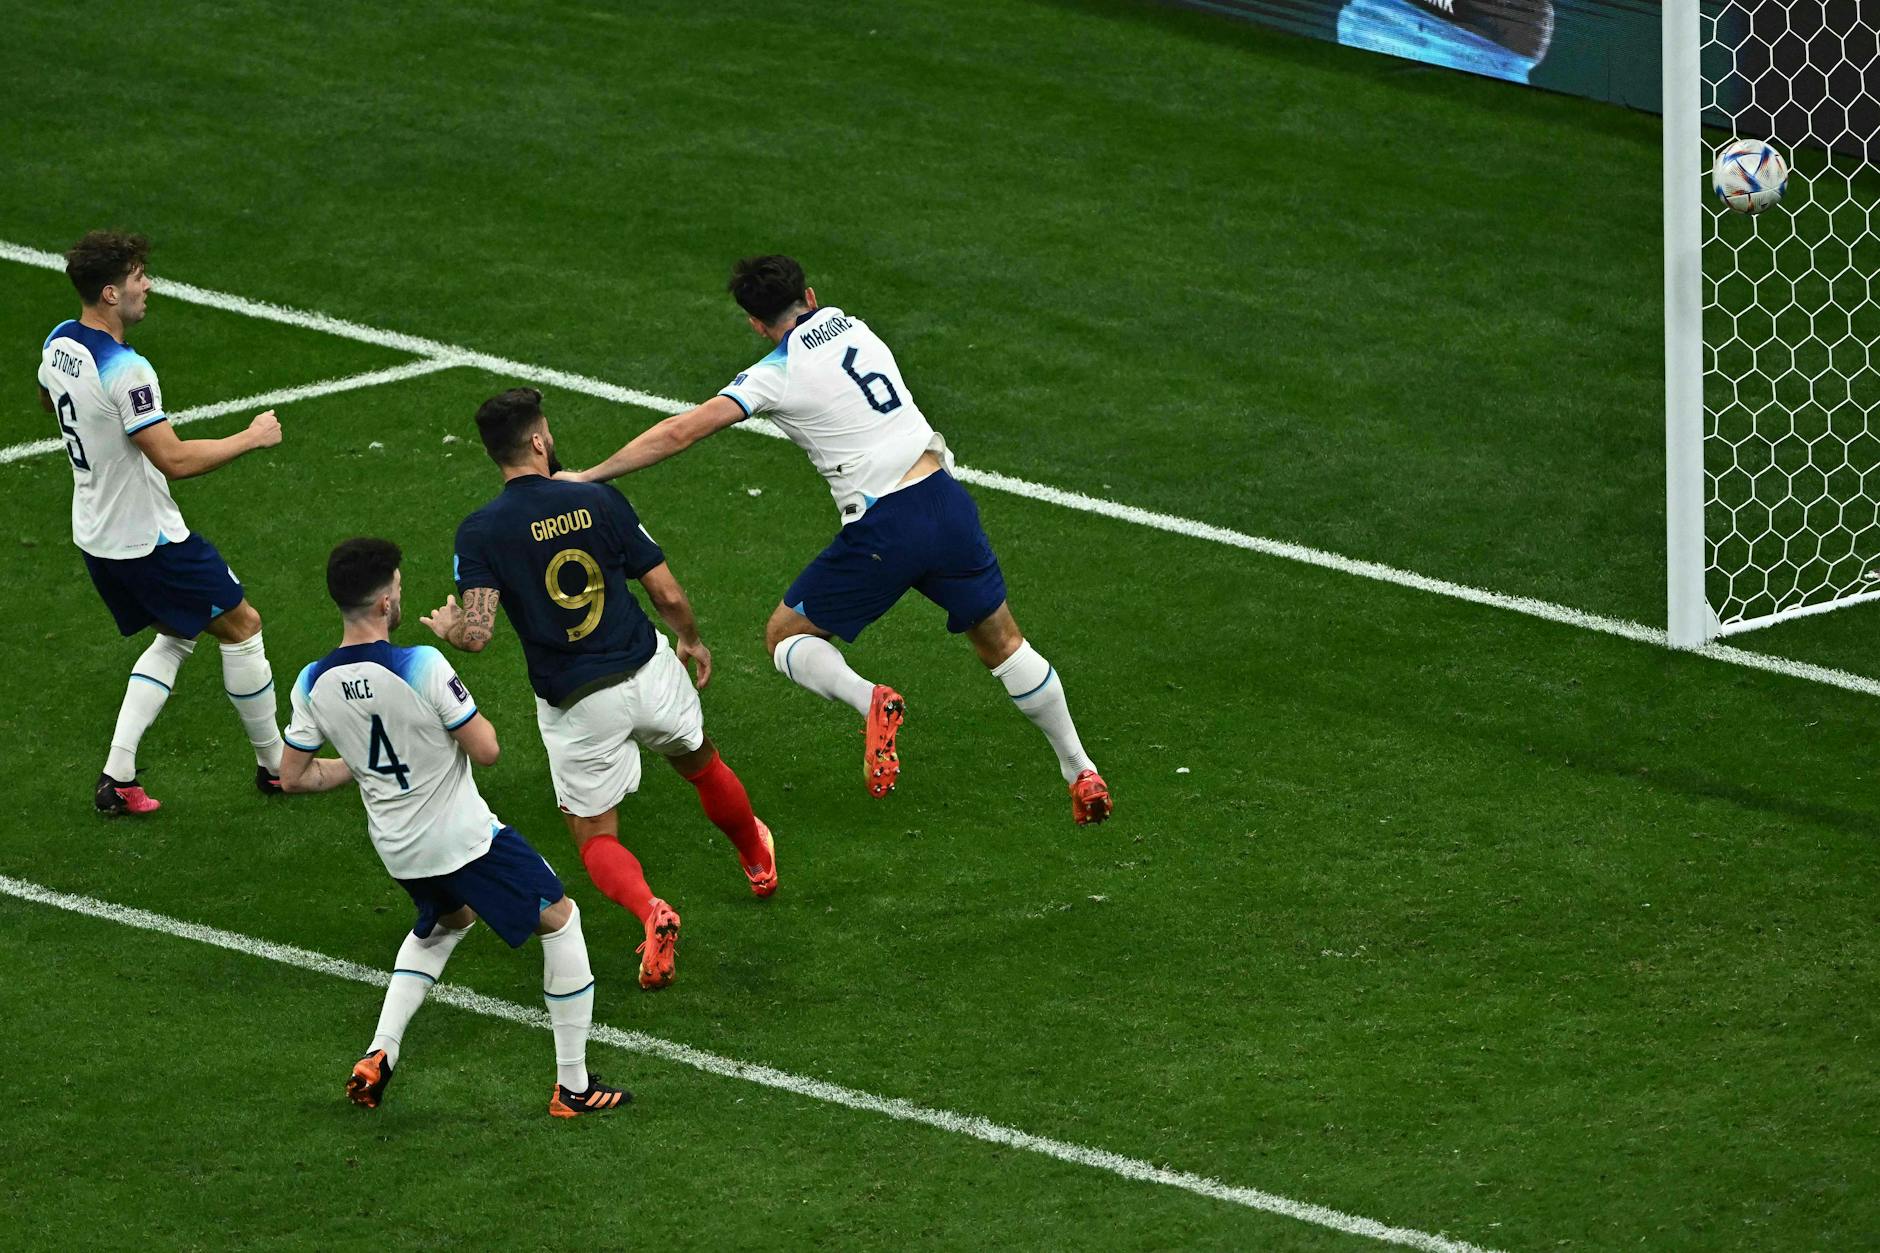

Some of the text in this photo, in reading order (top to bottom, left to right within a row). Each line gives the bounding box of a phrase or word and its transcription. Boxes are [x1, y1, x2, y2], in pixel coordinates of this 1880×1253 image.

[52, 349, 82, 378] STONES
[841, 345, 902, 414] 6
[58, 392, 91, 472] 5
[530, 508, 592, 542] GIROUD
[545, 548, 605, 642] 9
[341, 679, 373, 700] RICE
[368, 713, 410, 790] 4
